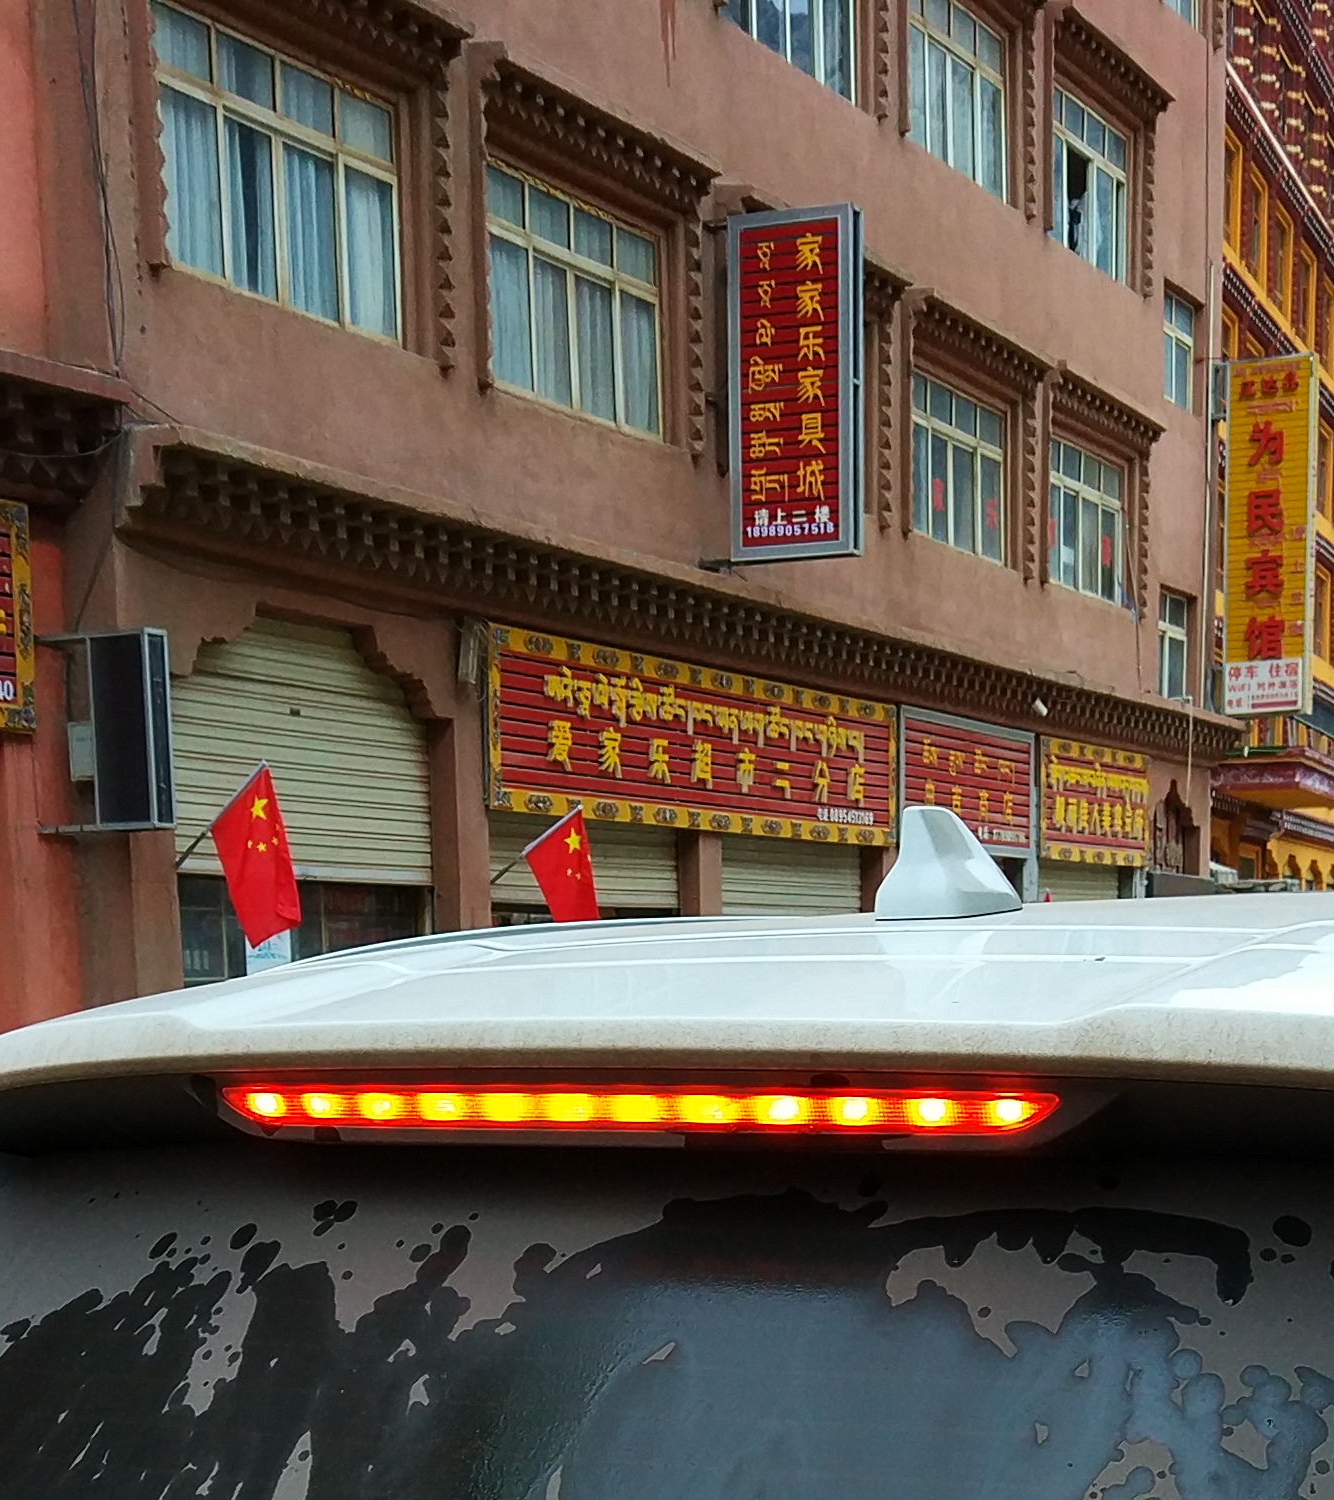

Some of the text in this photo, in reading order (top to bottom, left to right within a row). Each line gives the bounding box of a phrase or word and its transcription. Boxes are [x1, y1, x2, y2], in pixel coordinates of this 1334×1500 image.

[795, 232, 826, 501] 家家乐家具城
[746, 521, 835, 538] 18989057518
[754, 505, 830, 527] 请上二楼
[1244, 420, 1285, 660] 为民宾馆
[1268, 662, 1299, 678] 住宿
[547, 720, 865, 808] 爱家乐超市二分店
